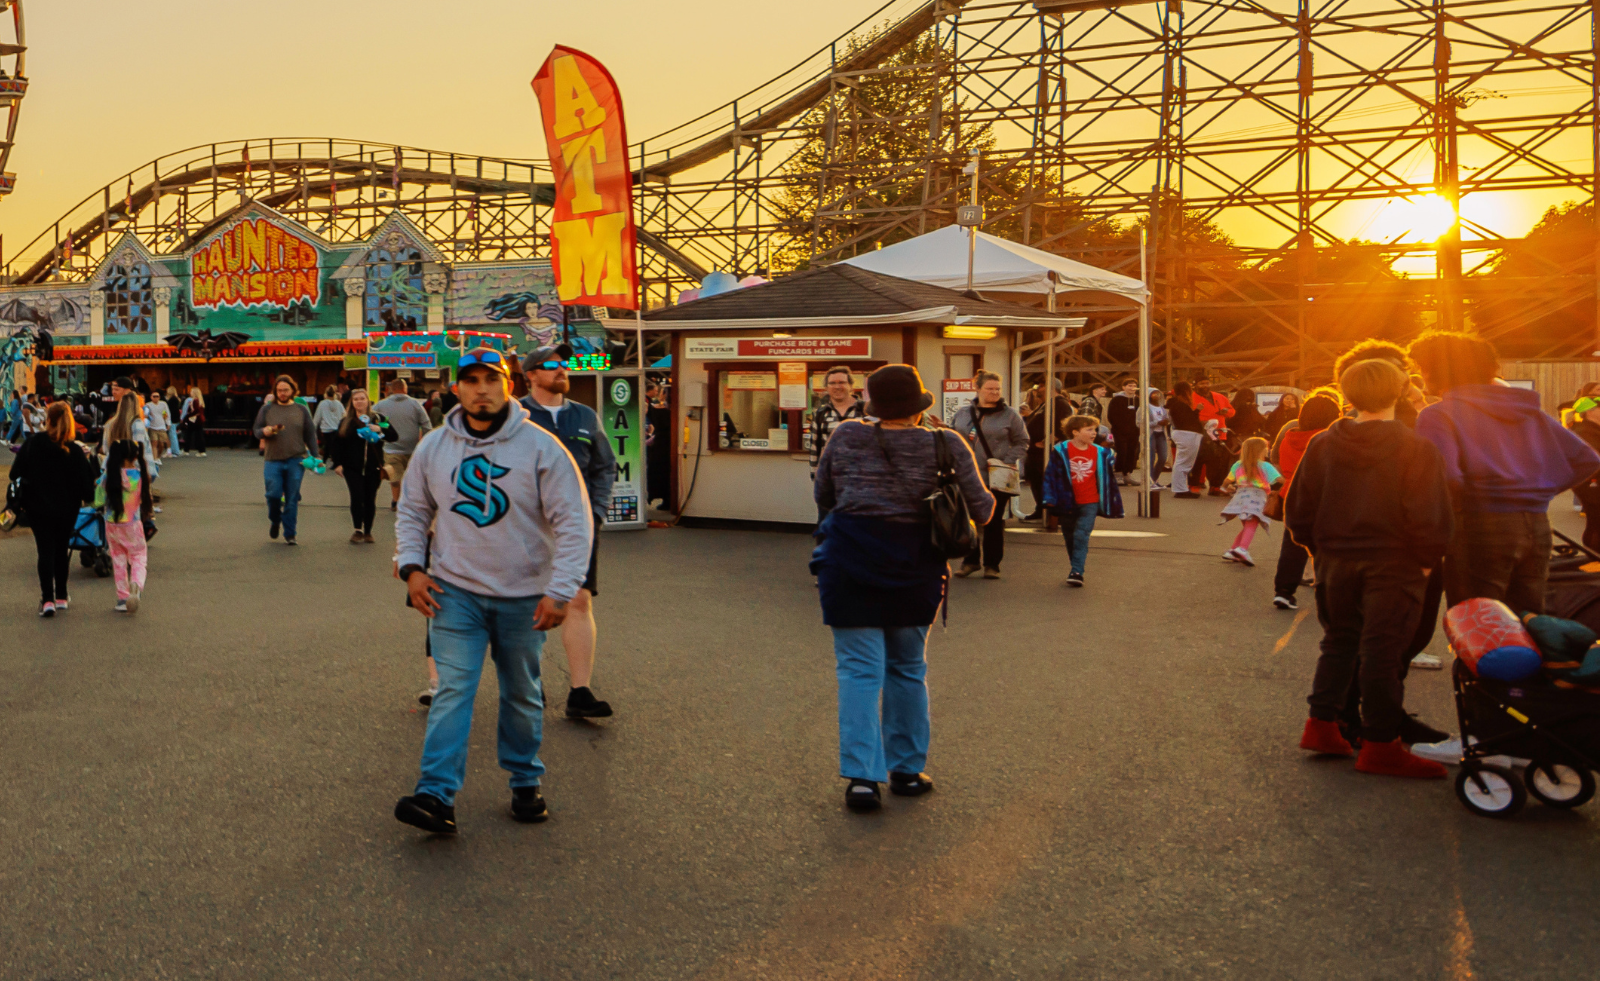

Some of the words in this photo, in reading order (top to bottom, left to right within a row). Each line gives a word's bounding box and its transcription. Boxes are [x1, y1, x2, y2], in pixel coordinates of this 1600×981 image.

[552, 54, 629, 301] ATM
[192, 218, 318, 275] HAUNTED
[192, 269, 319, 305] MANSION
[567, 356, 605, 368] ATM
[945, 381, 959, 390] SKIP
[960, 381, 971, 389] THE
[613, 409, 631, 482] ATM
